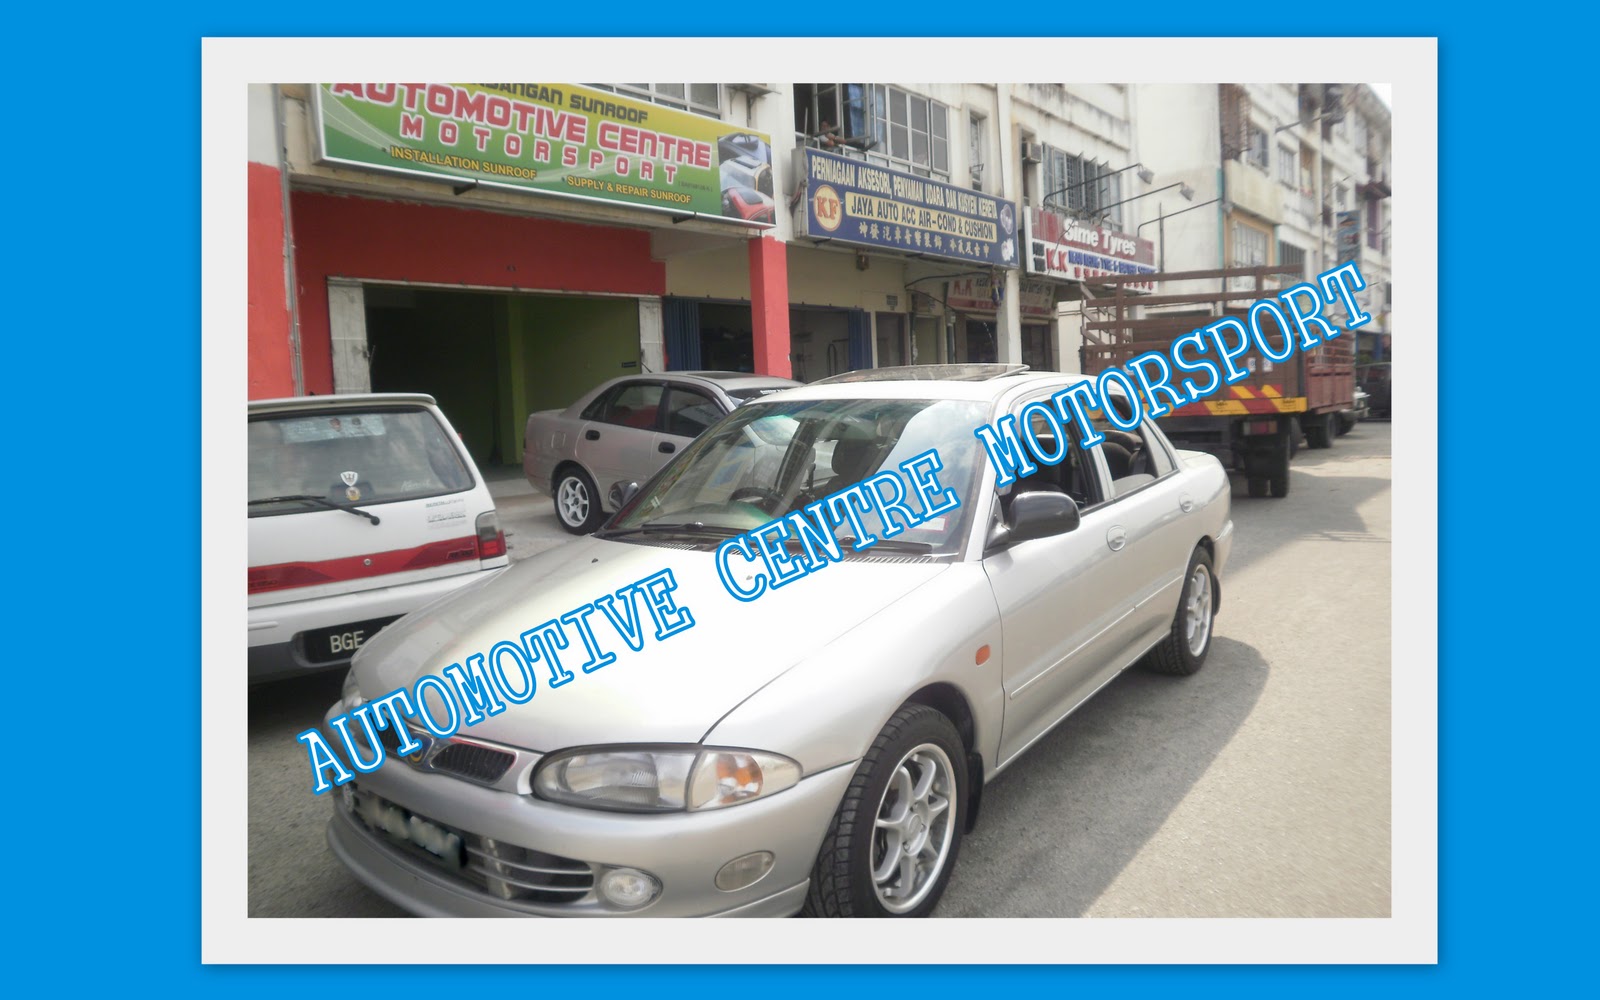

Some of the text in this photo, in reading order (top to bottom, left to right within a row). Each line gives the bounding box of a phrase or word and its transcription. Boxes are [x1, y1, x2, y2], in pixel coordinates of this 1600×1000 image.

[331, 83, 712, 170] AUTOMOTIVE CENTRE
[570, 94, 648, 124] SUNROOF
[390, 145, 537, 180] INSTALLATION SUNROOF
[567, 175, 692, 204] SUPPLY & REPAIR SUNROOF
[811, 155, 855, 187] PERNIAGAAN
[925, 184, 944, 207] UDARA
[816, 195, 839, 221] KF
[851, 195, 994, 240] JAYA AUTO ACC AIR-COND & CUSHION
[1063, 218, 1137, 255] Sime Tyres
[330, 630, 365, 653] BGE
